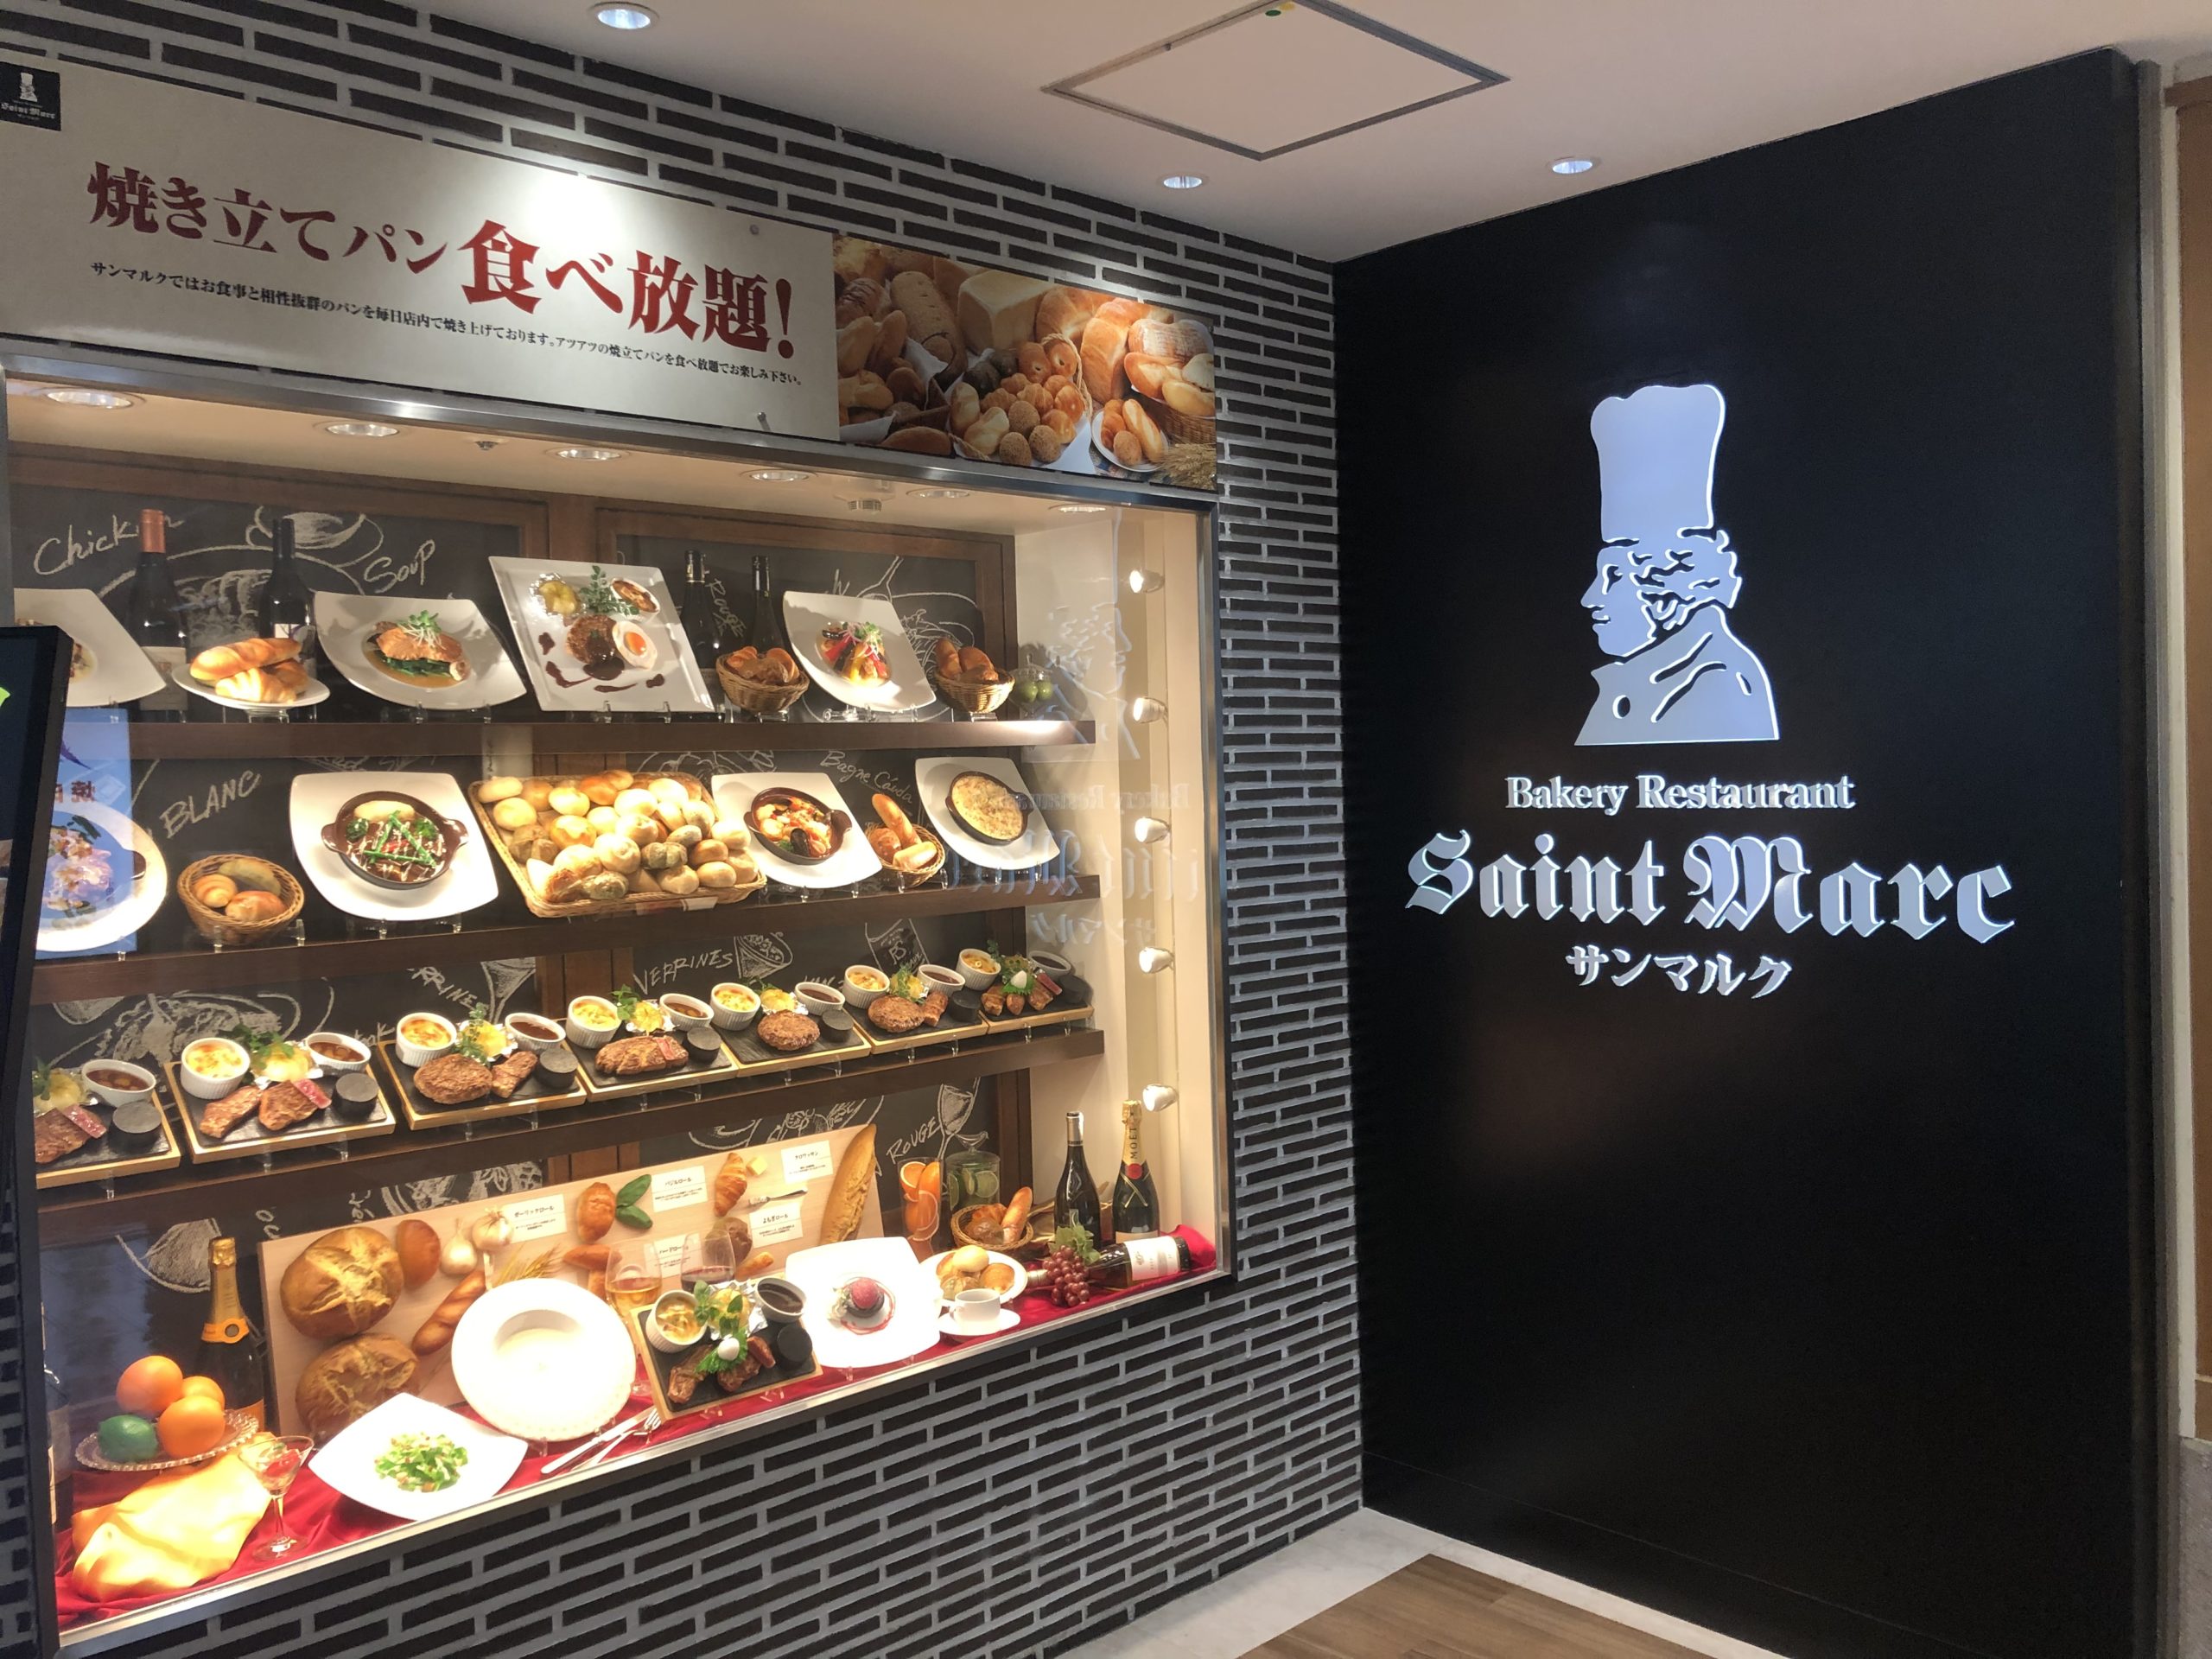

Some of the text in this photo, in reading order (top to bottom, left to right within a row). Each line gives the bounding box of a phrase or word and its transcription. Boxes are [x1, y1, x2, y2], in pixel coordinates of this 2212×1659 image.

[159, 770, 261, 839] BLANC
[1505, 775, 1857, 816] Bakery Restaurant
[1405, 830, 2016, 944] Saint Marc
[1566, 945, 1793, 999] サンマルク
